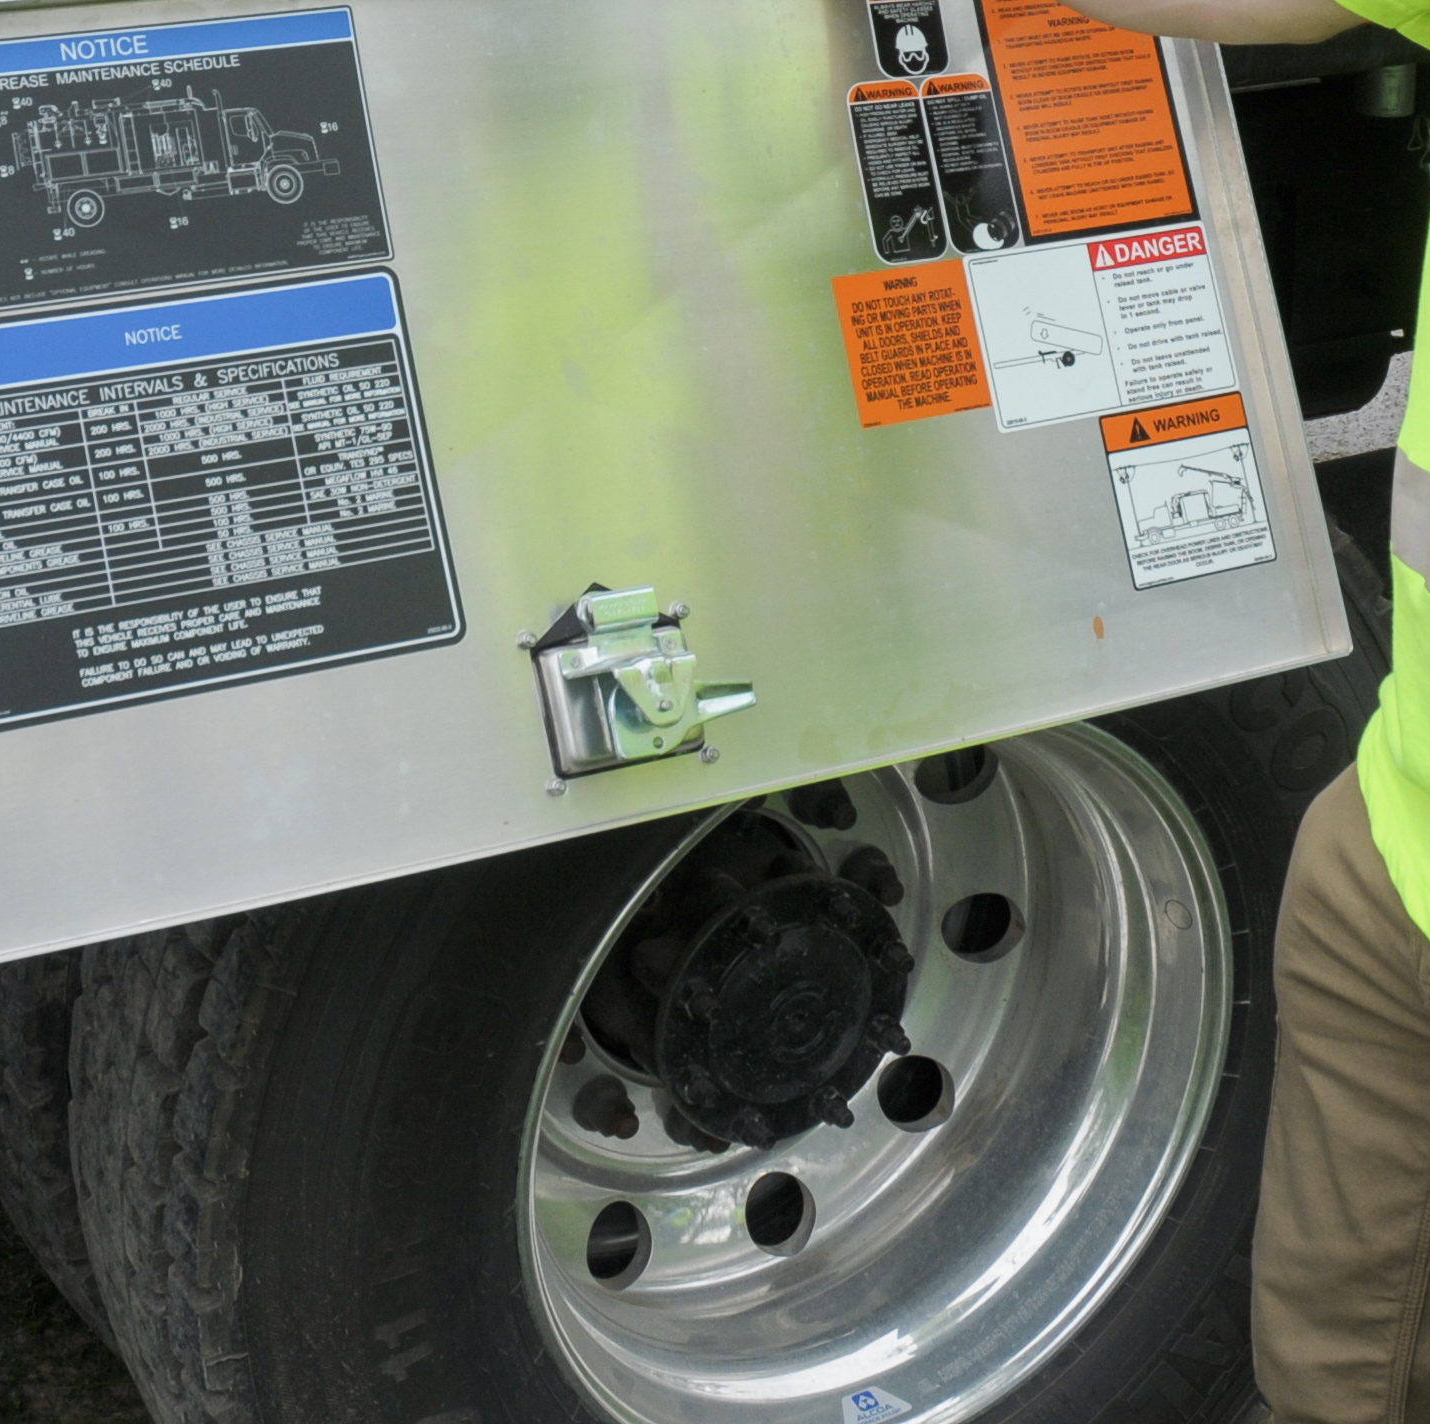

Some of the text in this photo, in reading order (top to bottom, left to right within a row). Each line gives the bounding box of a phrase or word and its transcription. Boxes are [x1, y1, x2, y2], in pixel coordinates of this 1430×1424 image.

[1048, 16, 1090, 28] WARNING
[59, 35, 148, 61] NOTICE
[56, 62, 161, 85] MAINTENANCE
[163, 54, 240, 74] SCHEDULE
[160, 78, 172, 88] 40
[939, 80, 985, 92] WARNING
[866, 87, 912, 98] WARNING
[21, 97, 33, 107] 40
[328, 122, 338, 131] 16
[8, 166, 15, 175] 8
[1114, 232, 1202, 263] DANGER
[883, 277, 918, 291] WARNING
[852, 302, 864, 313] DO
[865, 299, 881, 311] NOT
[883, 294, 911, 308] TOUCH
[912, 292, 927, 304] ANY
[867, 313, 879, 323] OR
[880, 307, 910, 322] MOVING
[912, 304, 937, 316] PARTS
[939, 300, 961, 312] WHEN
[856, 327, 874, 338] UNIT
[875, 326, 883, 335] IS
[885, 324, 893, 334] IN
[941, 313, 961, 324] KEEP
[124, 324, 182, 346] NOTICE
[99, 375, 184, 401] INTERVALS
[194, 373, 208, 388] &
[217, 353, 340, 384] SPECIFICATIONS
[1153, 409, 1220, 432] WARNING
[90, 425, 109, 435] 200
[43, 477, 66, 490] CASE
[69, 476, 84, 485] OIL
[858, 1404, 893, 1421] ALCOA
